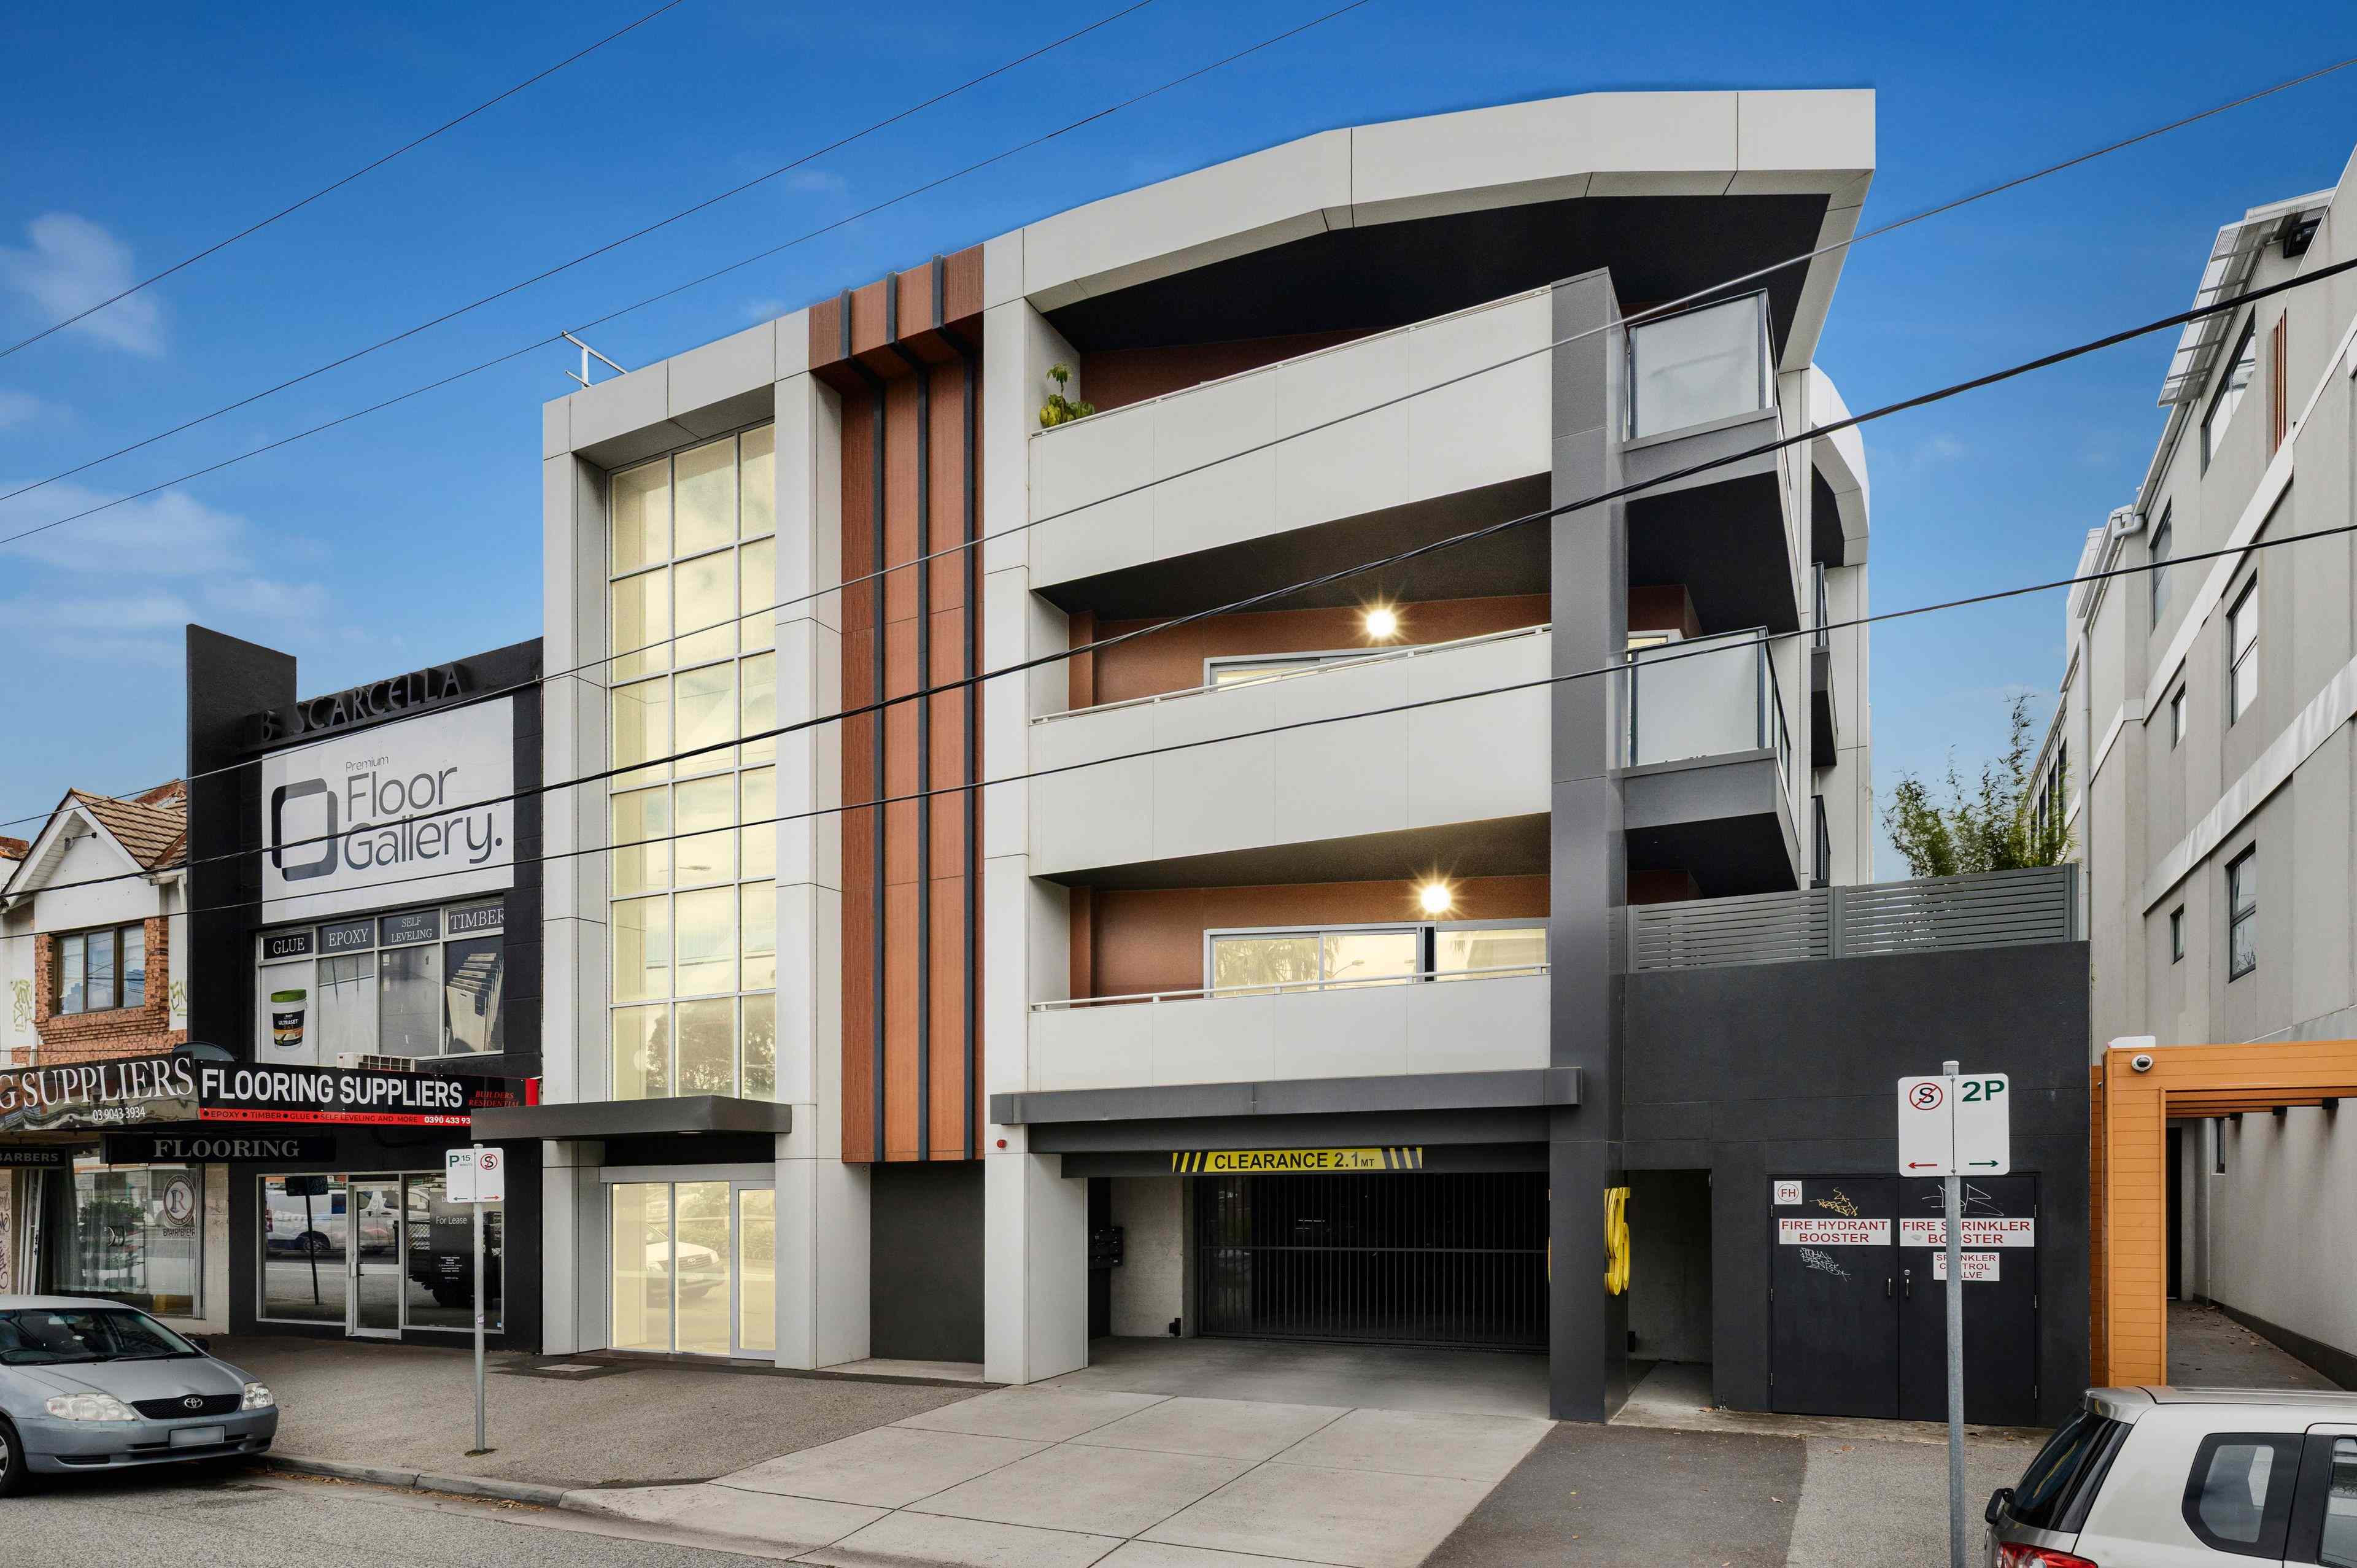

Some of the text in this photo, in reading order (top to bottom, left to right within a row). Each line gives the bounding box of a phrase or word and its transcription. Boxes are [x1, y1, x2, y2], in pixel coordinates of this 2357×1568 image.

[262, 661, 462, 741] B SCARCELLA
[345, 755, 389, 772] Premium
[347, 767, 457, 822] Floor
[401, 916, 422, 928] SELF
[450, 908, 505, 930] TIMBER
[328, 928, 369, 948] EPOXY
[391, 929, 433, 943] LEVELING
[273, 937, 305, 955] GLUE
[21, 1057, 195, 1108] SUPPLIERS
[202, 1068, 463, 1108] FLOORING SUPPLIERS
[475, 1090, 514, 1099] BUILDERS
[1961, 1079, 2005, 1103] 2P
[125, 1106, 145, 1119] 3934
[153, 1140, 300, 1158] FLOORING
[0, 1153, 60, 1162] ARBERS
[449, 1155, 460, 1167] P
[1213, 1152, 1328, 1170] CLEARANCE
[1781, 1188, 1797, 1198] FH
[436, 1216, 467, 1224] For Lease
[1781, 1220, 1888, 1230] FIRE HYDRANT
[1902, 1220, 2032, 1232] FIRE SRINKLER
[1798, 1232, 1870, 1243] BOOSTER
[1927, 1233, 2004, 1244] BOSTER
[1939, 1262, 1991, 1271] CTROL
